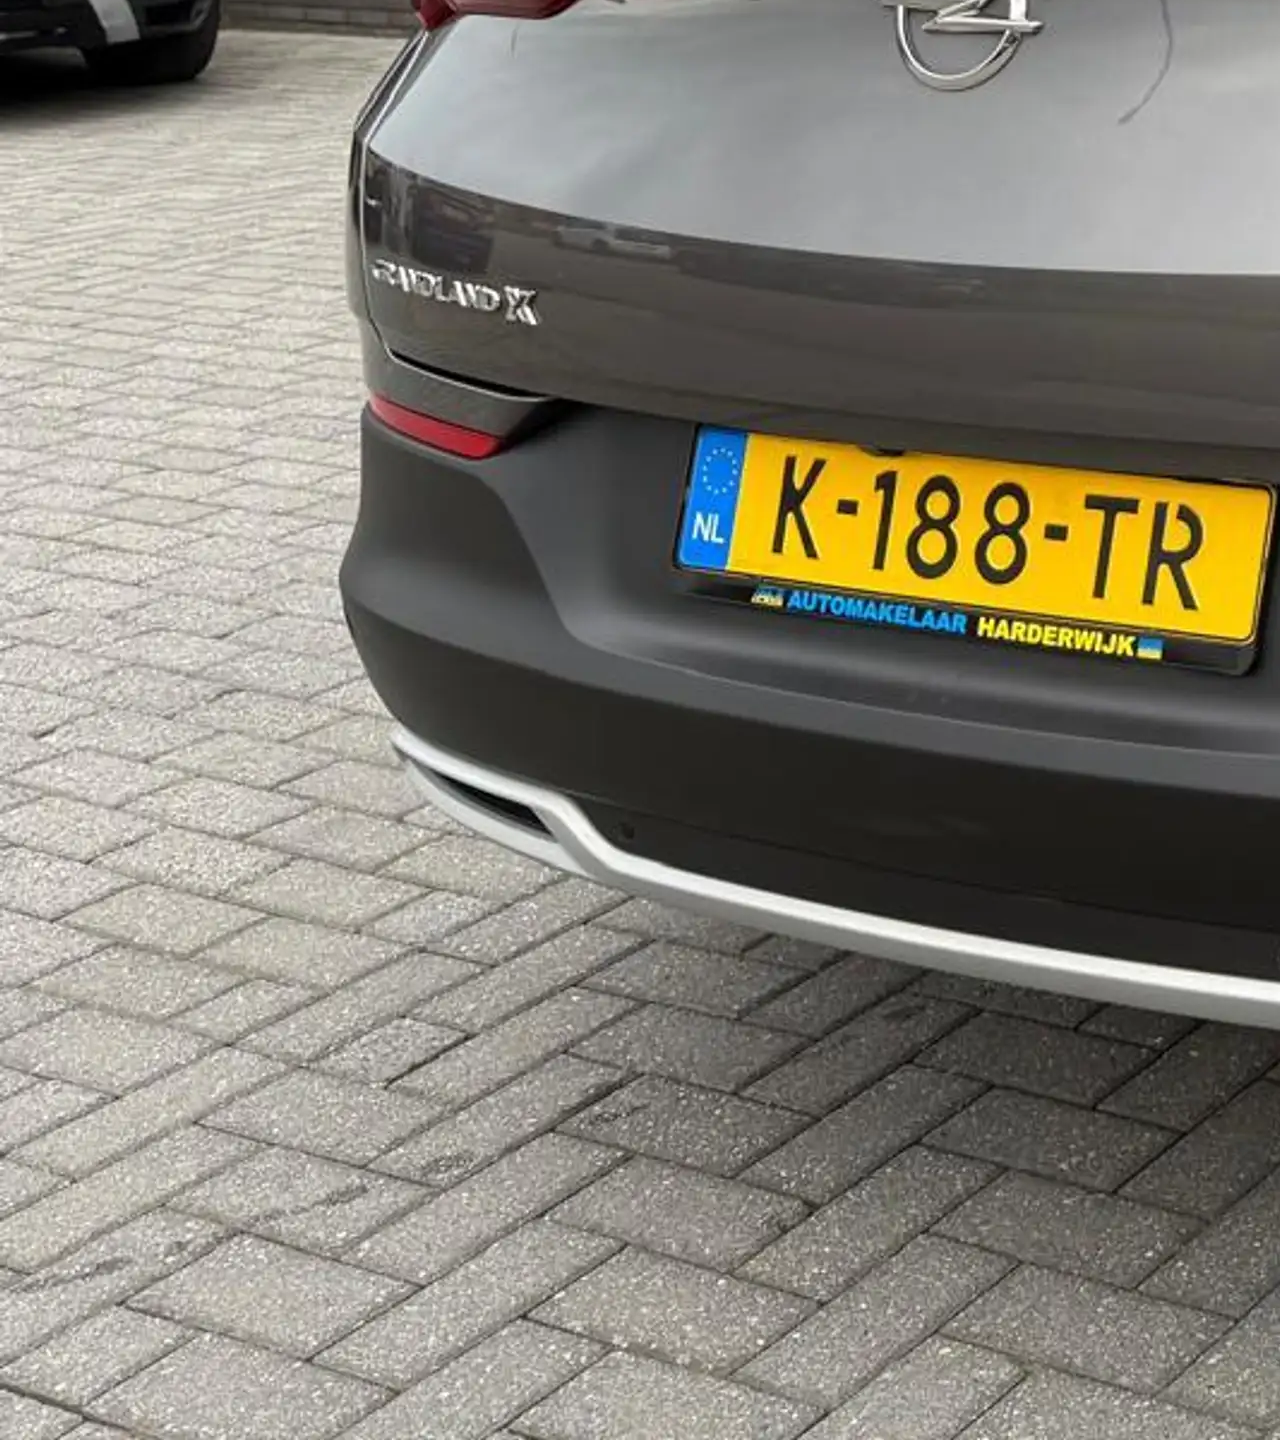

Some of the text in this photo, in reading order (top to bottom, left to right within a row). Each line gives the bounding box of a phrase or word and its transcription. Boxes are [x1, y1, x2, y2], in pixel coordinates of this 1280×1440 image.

[693, 512, 724, 545] NL
[771, 455, 1202, 612] K-188-TR
[787, 589, 967, 634] AUTOMAKELAAR
[977, 616, 1135, 658] HARDERWIJK
